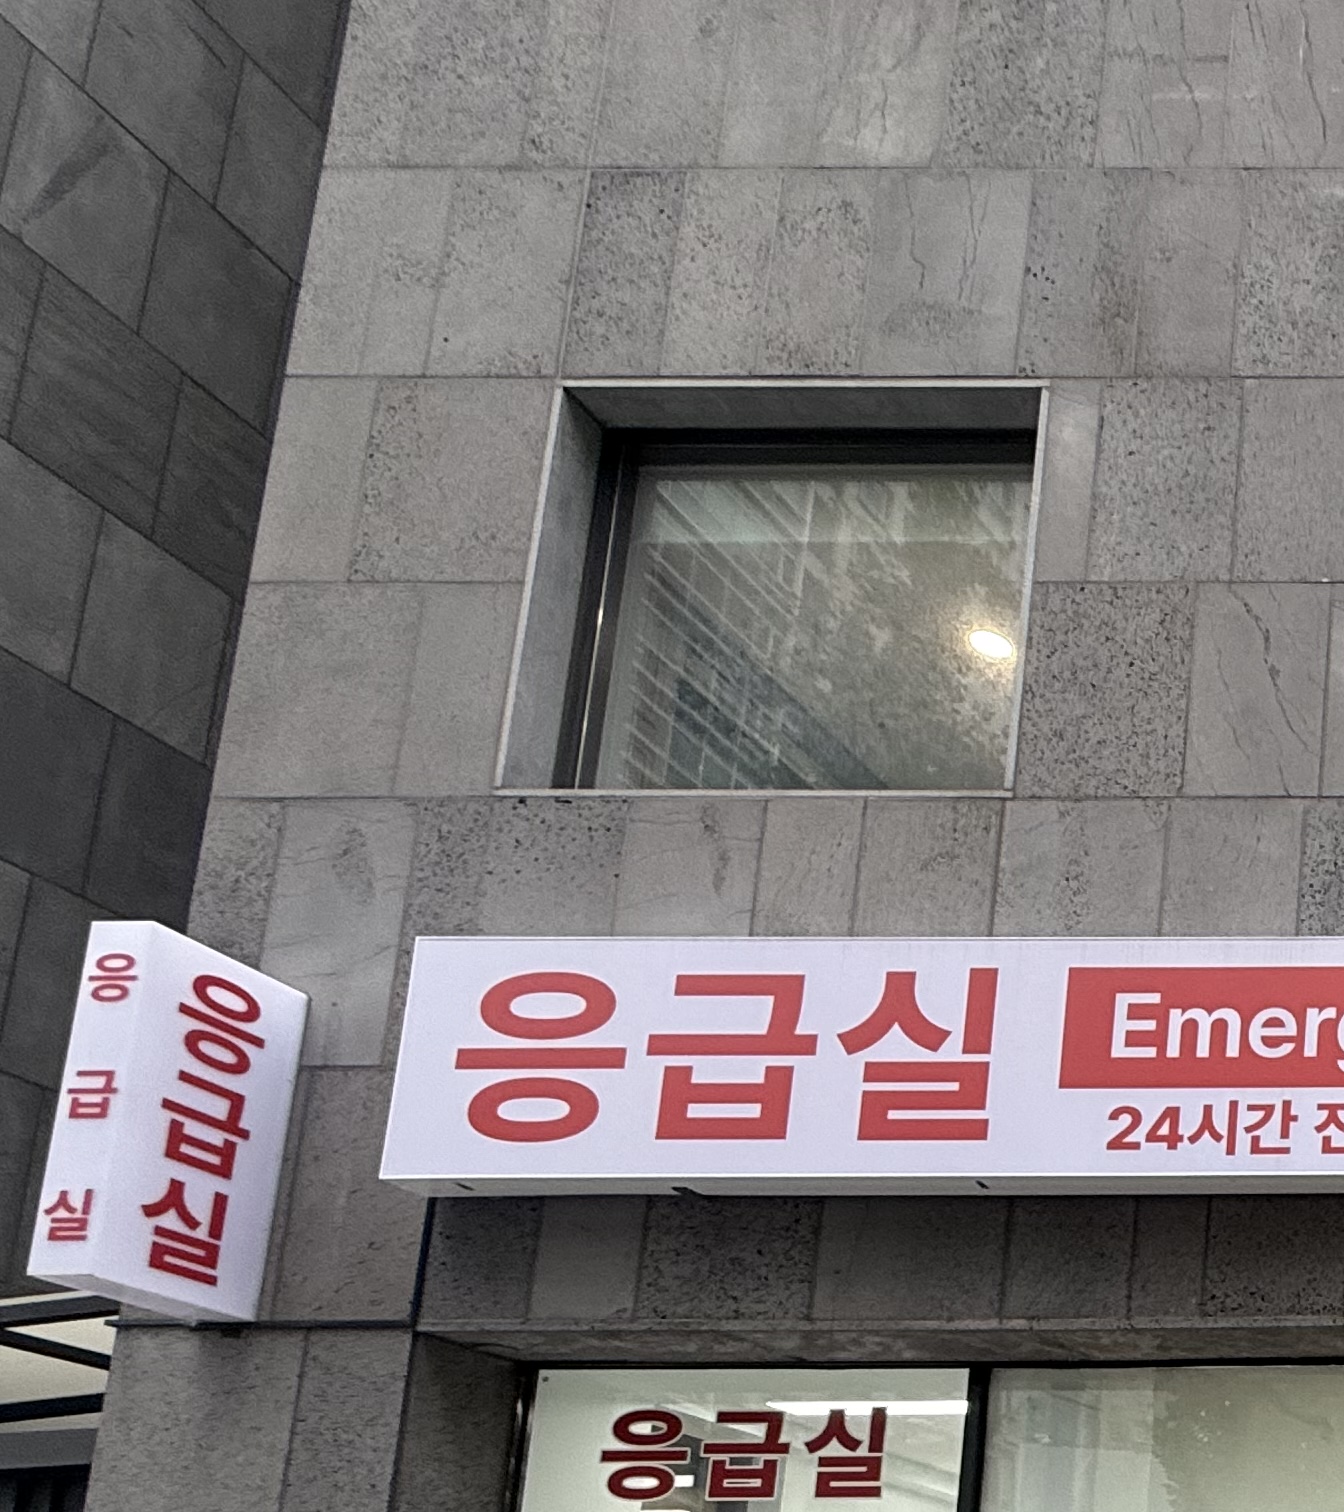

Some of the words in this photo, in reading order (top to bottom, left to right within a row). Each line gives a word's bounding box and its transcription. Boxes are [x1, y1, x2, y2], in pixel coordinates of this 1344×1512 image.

[44, 953, 139, 1243] 응급실
[141, 974, 265, 1287] 응급실
[455, 967, 999, 1143] 응급실
[1106, 1100, 1298, 1157] 24시간
[600, 1406, 887, 1501] 응급실
